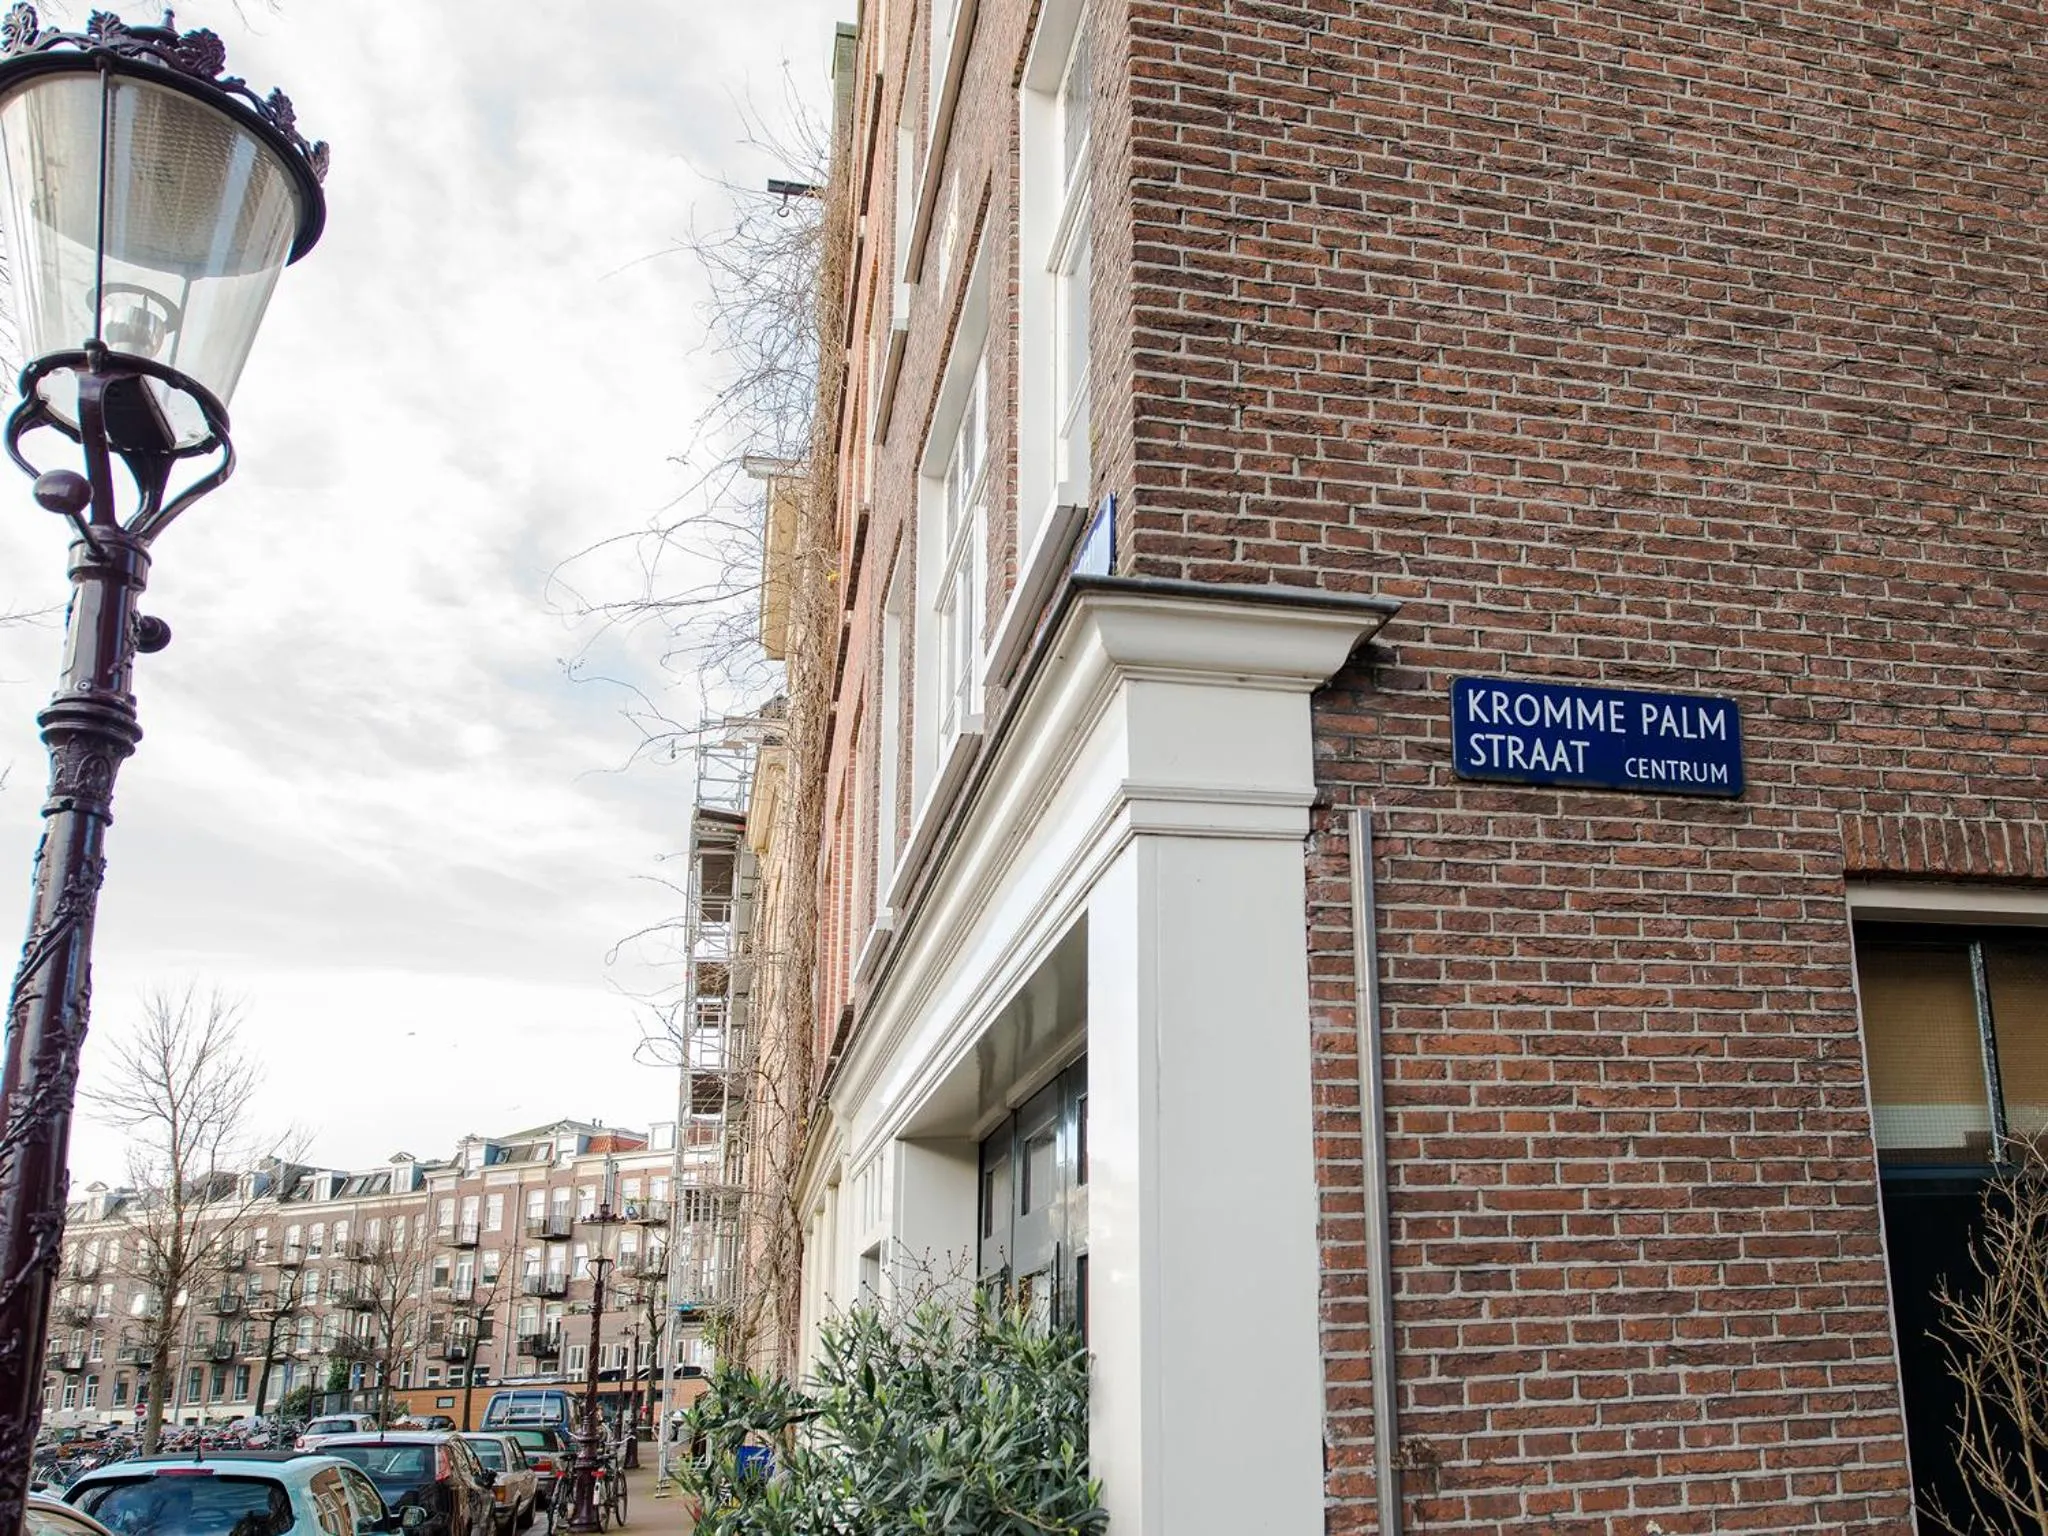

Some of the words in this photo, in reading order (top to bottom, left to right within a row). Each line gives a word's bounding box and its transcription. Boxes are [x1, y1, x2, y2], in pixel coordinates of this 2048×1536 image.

[1468, 689, 1626, 733] KROMME
[1641, 703, 1726, 741] PALM
[1470, 733, 1590, 773] STRAAT
[1625, 757, 1728, 784] CENTRUM
